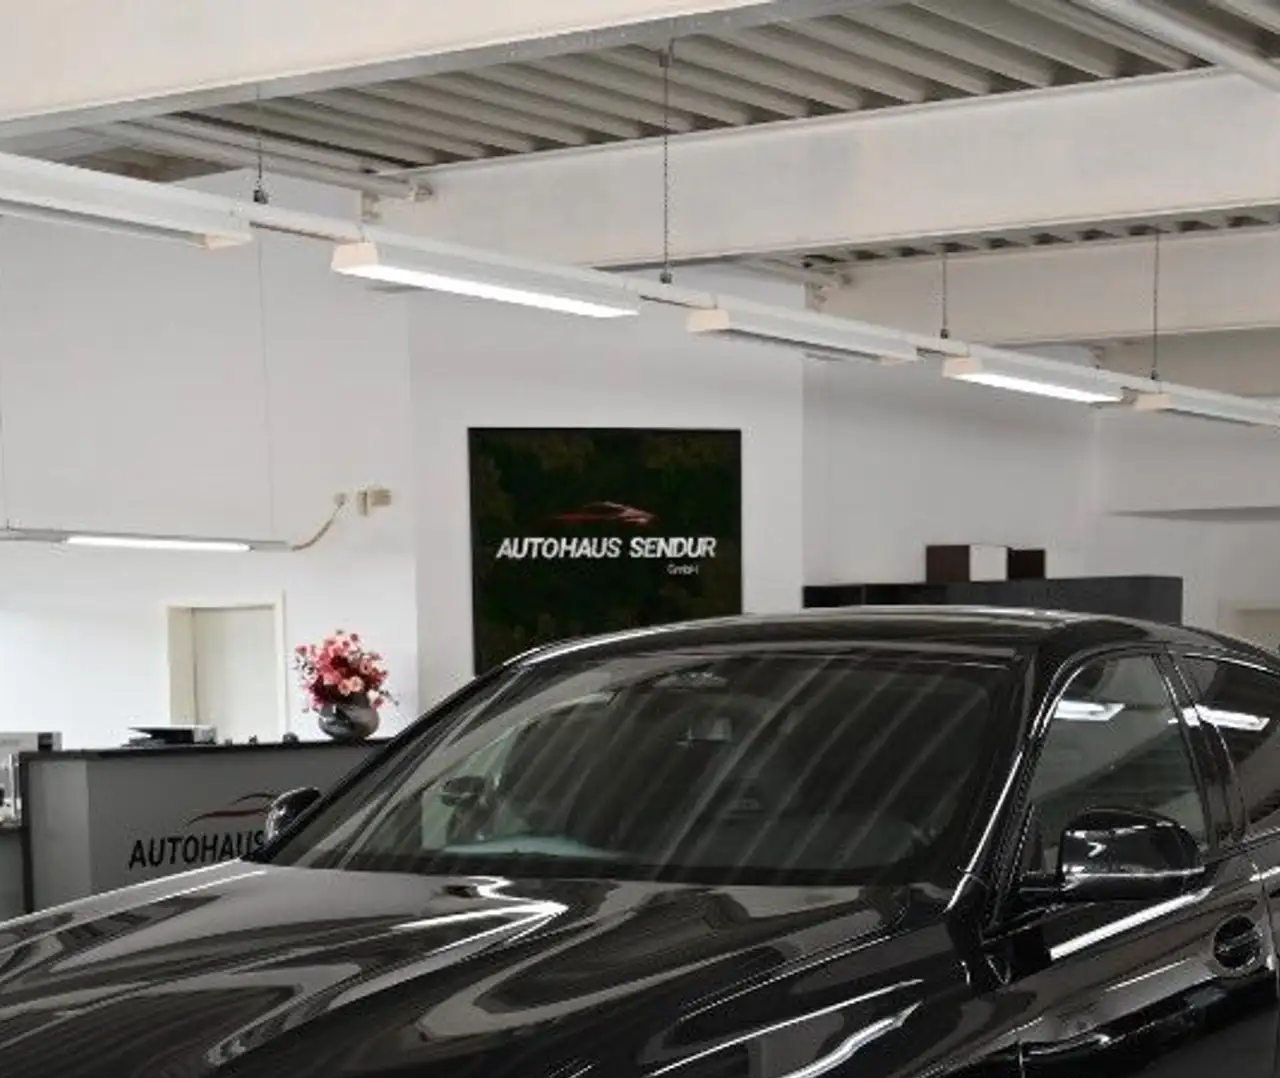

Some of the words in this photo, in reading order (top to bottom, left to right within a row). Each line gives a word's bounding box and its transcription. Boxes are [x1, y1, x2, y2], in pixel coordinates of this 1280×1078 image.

[496, 537, 622, 559] AUTOHAUS
[629, 537, 717, 558] SENDUR
[667, 563, 699, 575] GmbH
